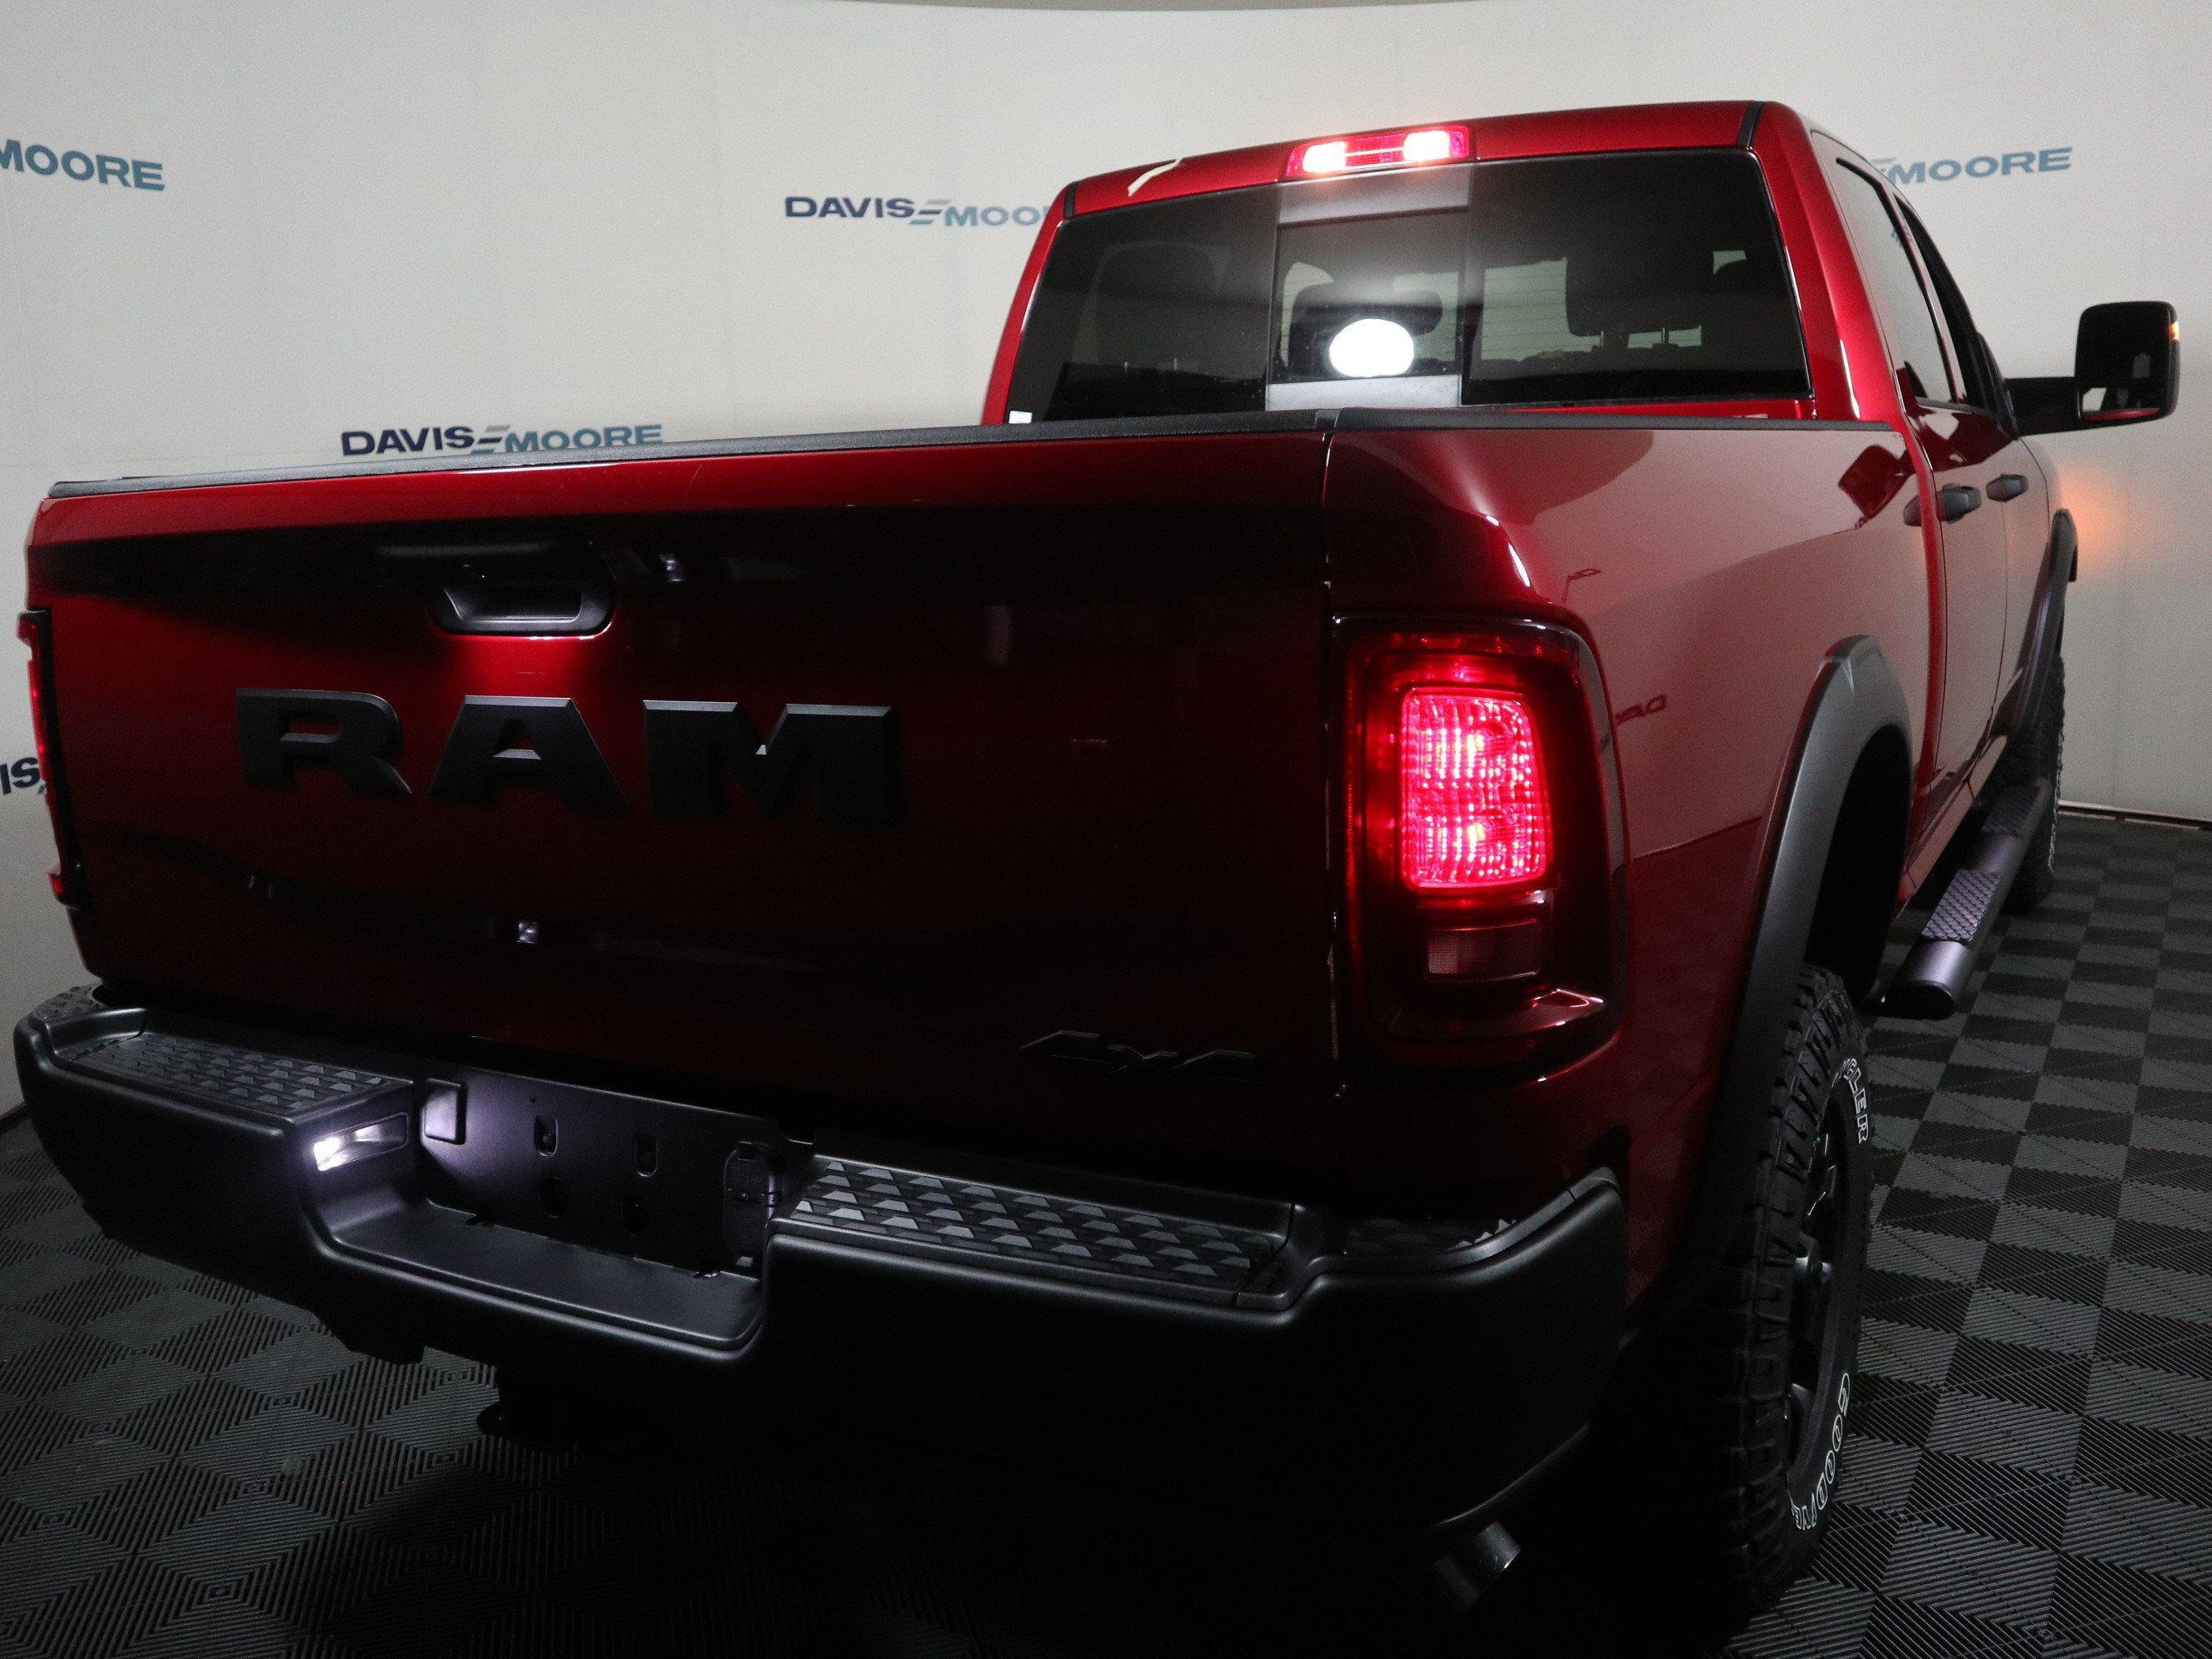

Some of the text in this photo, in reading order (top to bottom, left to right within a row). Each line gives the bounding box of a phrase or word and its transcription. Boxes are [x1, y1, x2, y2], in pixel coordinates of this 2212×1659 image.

[1886, 147, 2073, 185] MOORE
[785, 196, 1051, 227] DAVIS MOO
[341, 424, 663, 456] DAVIS MOORE
[235, 687, 903, 825] RAM
[1791, 1373, 1851, 1531] GOODYE
